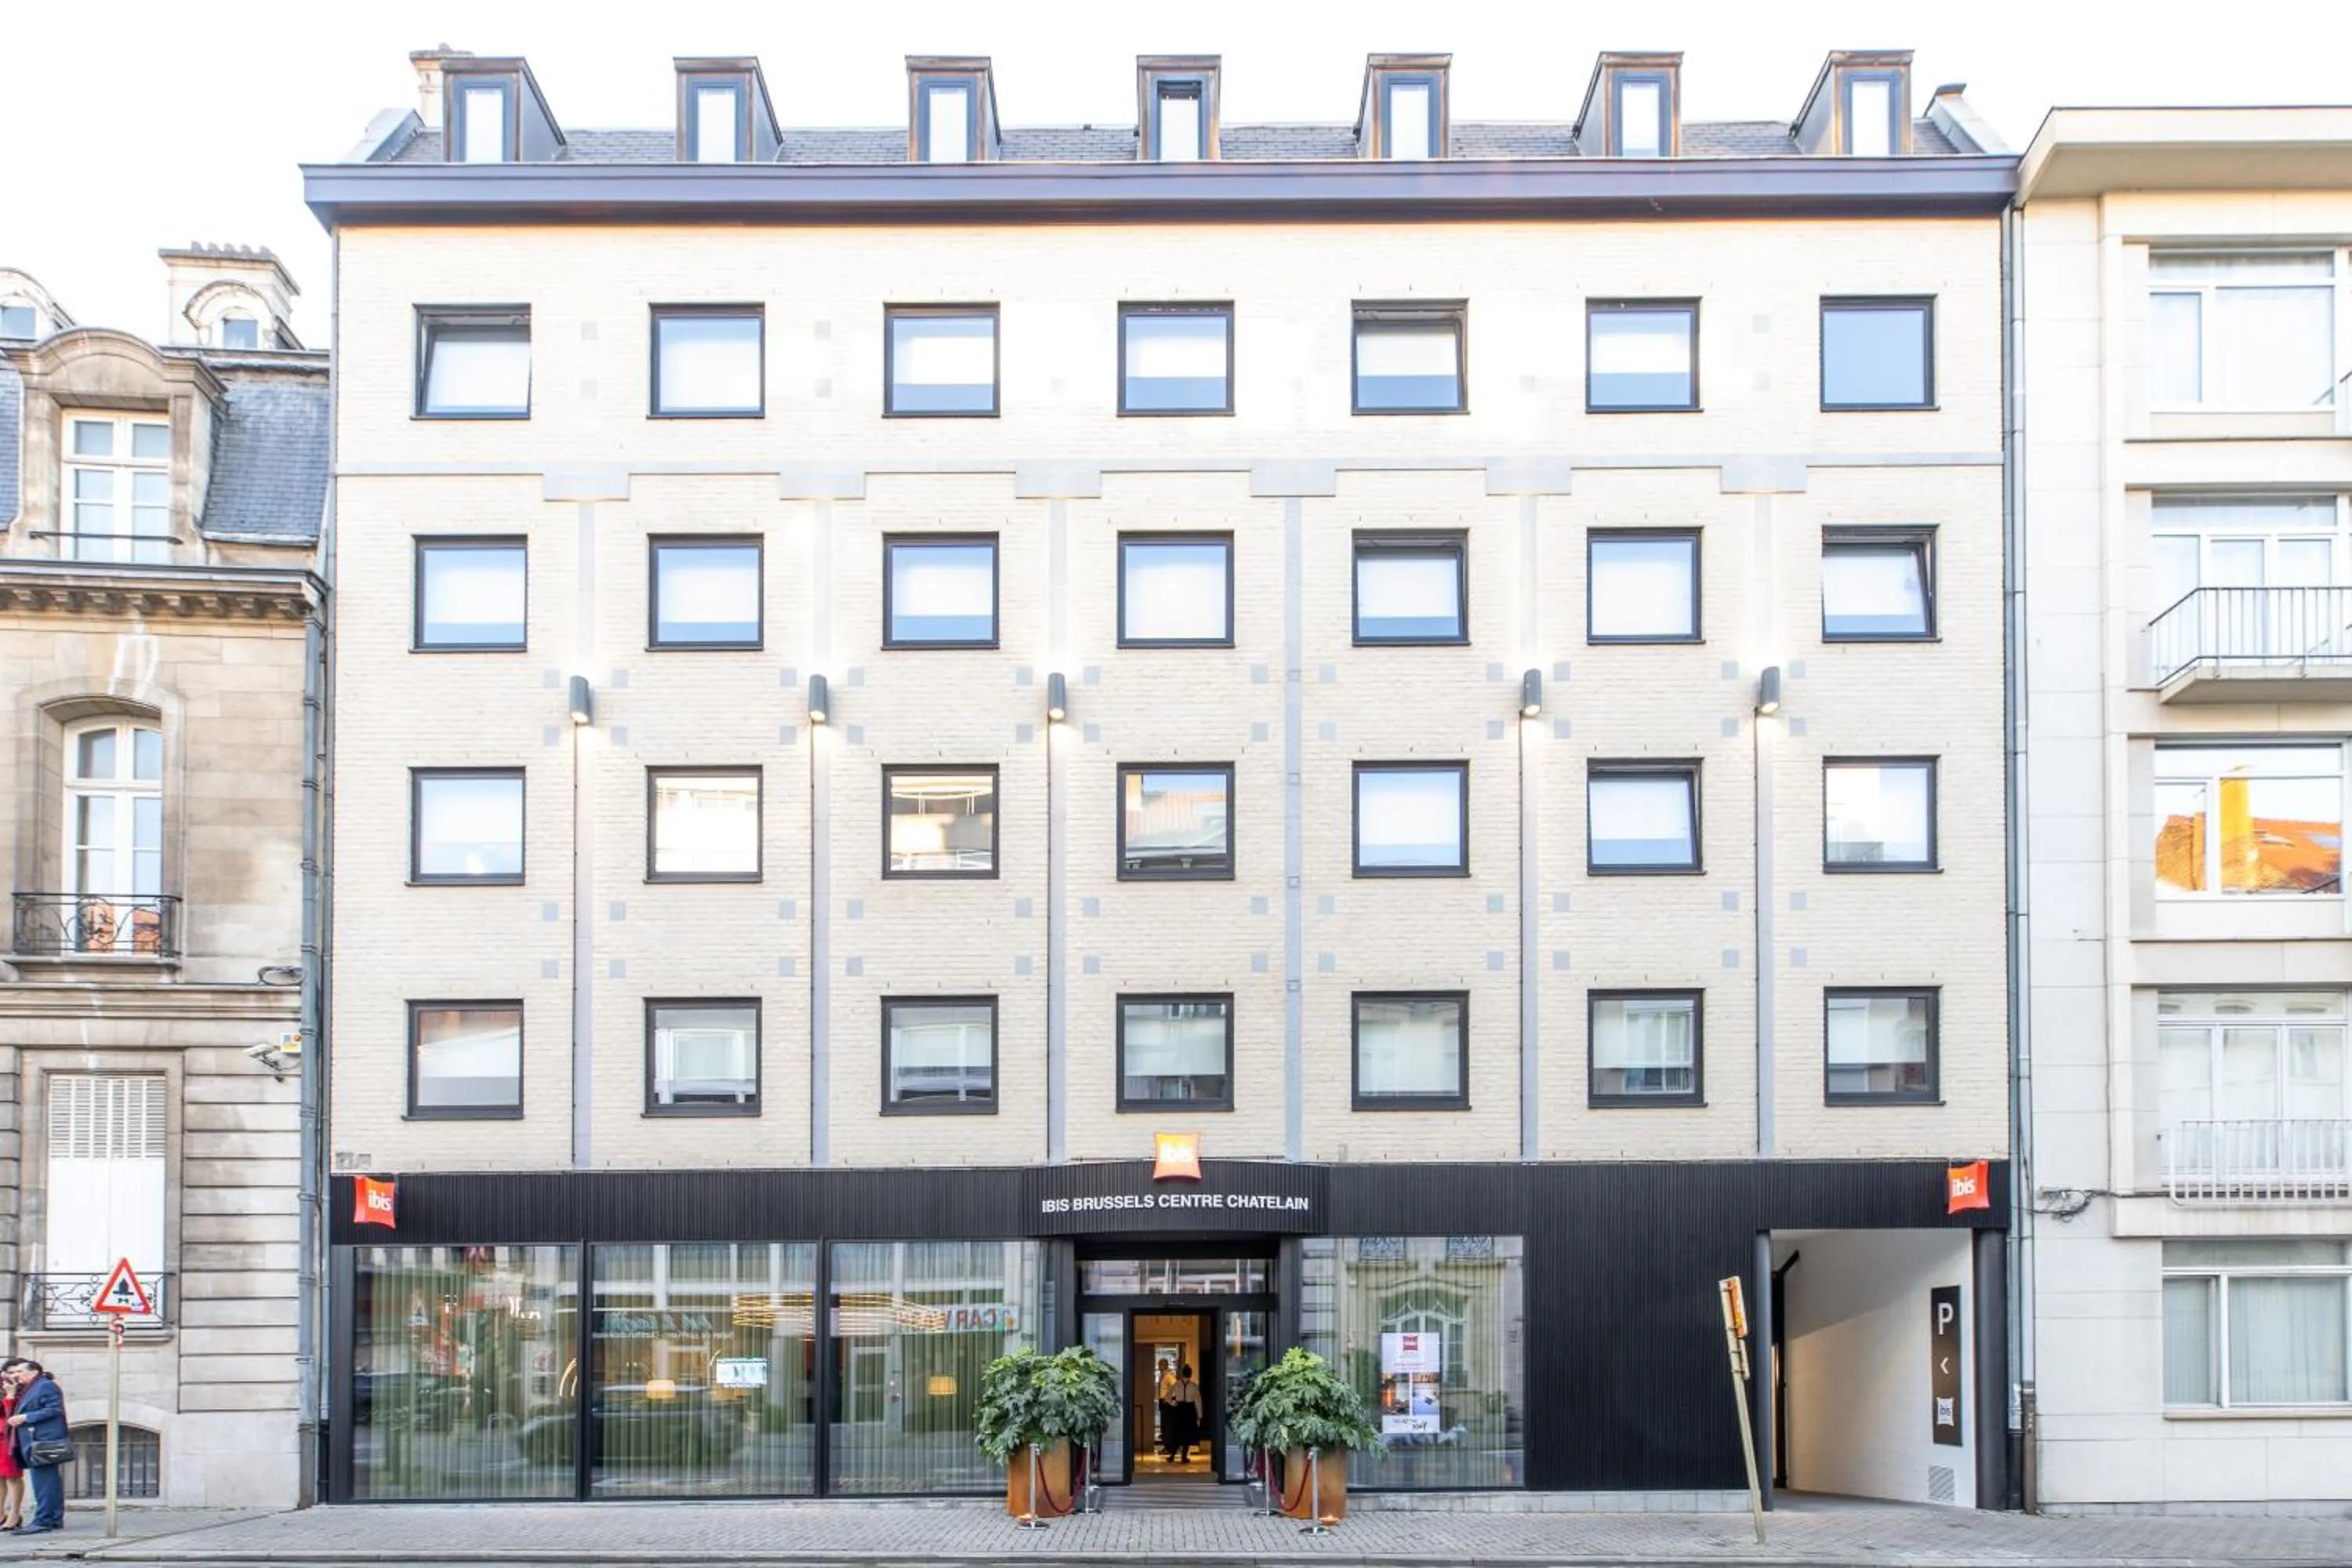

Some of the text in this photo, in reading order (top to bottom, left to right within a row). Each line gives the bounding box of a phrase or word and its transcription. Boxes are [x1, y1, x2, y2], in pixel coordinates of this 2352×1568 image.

[1951, 1176, 1975, 1197] ibis
[368, 1189, 392, 1211] ibis
[1042, 1194, 1308, 1213] IBIS BRUSSELS CENTRE CHATELAIN
[1937, 1301, 1954, 1334] P
